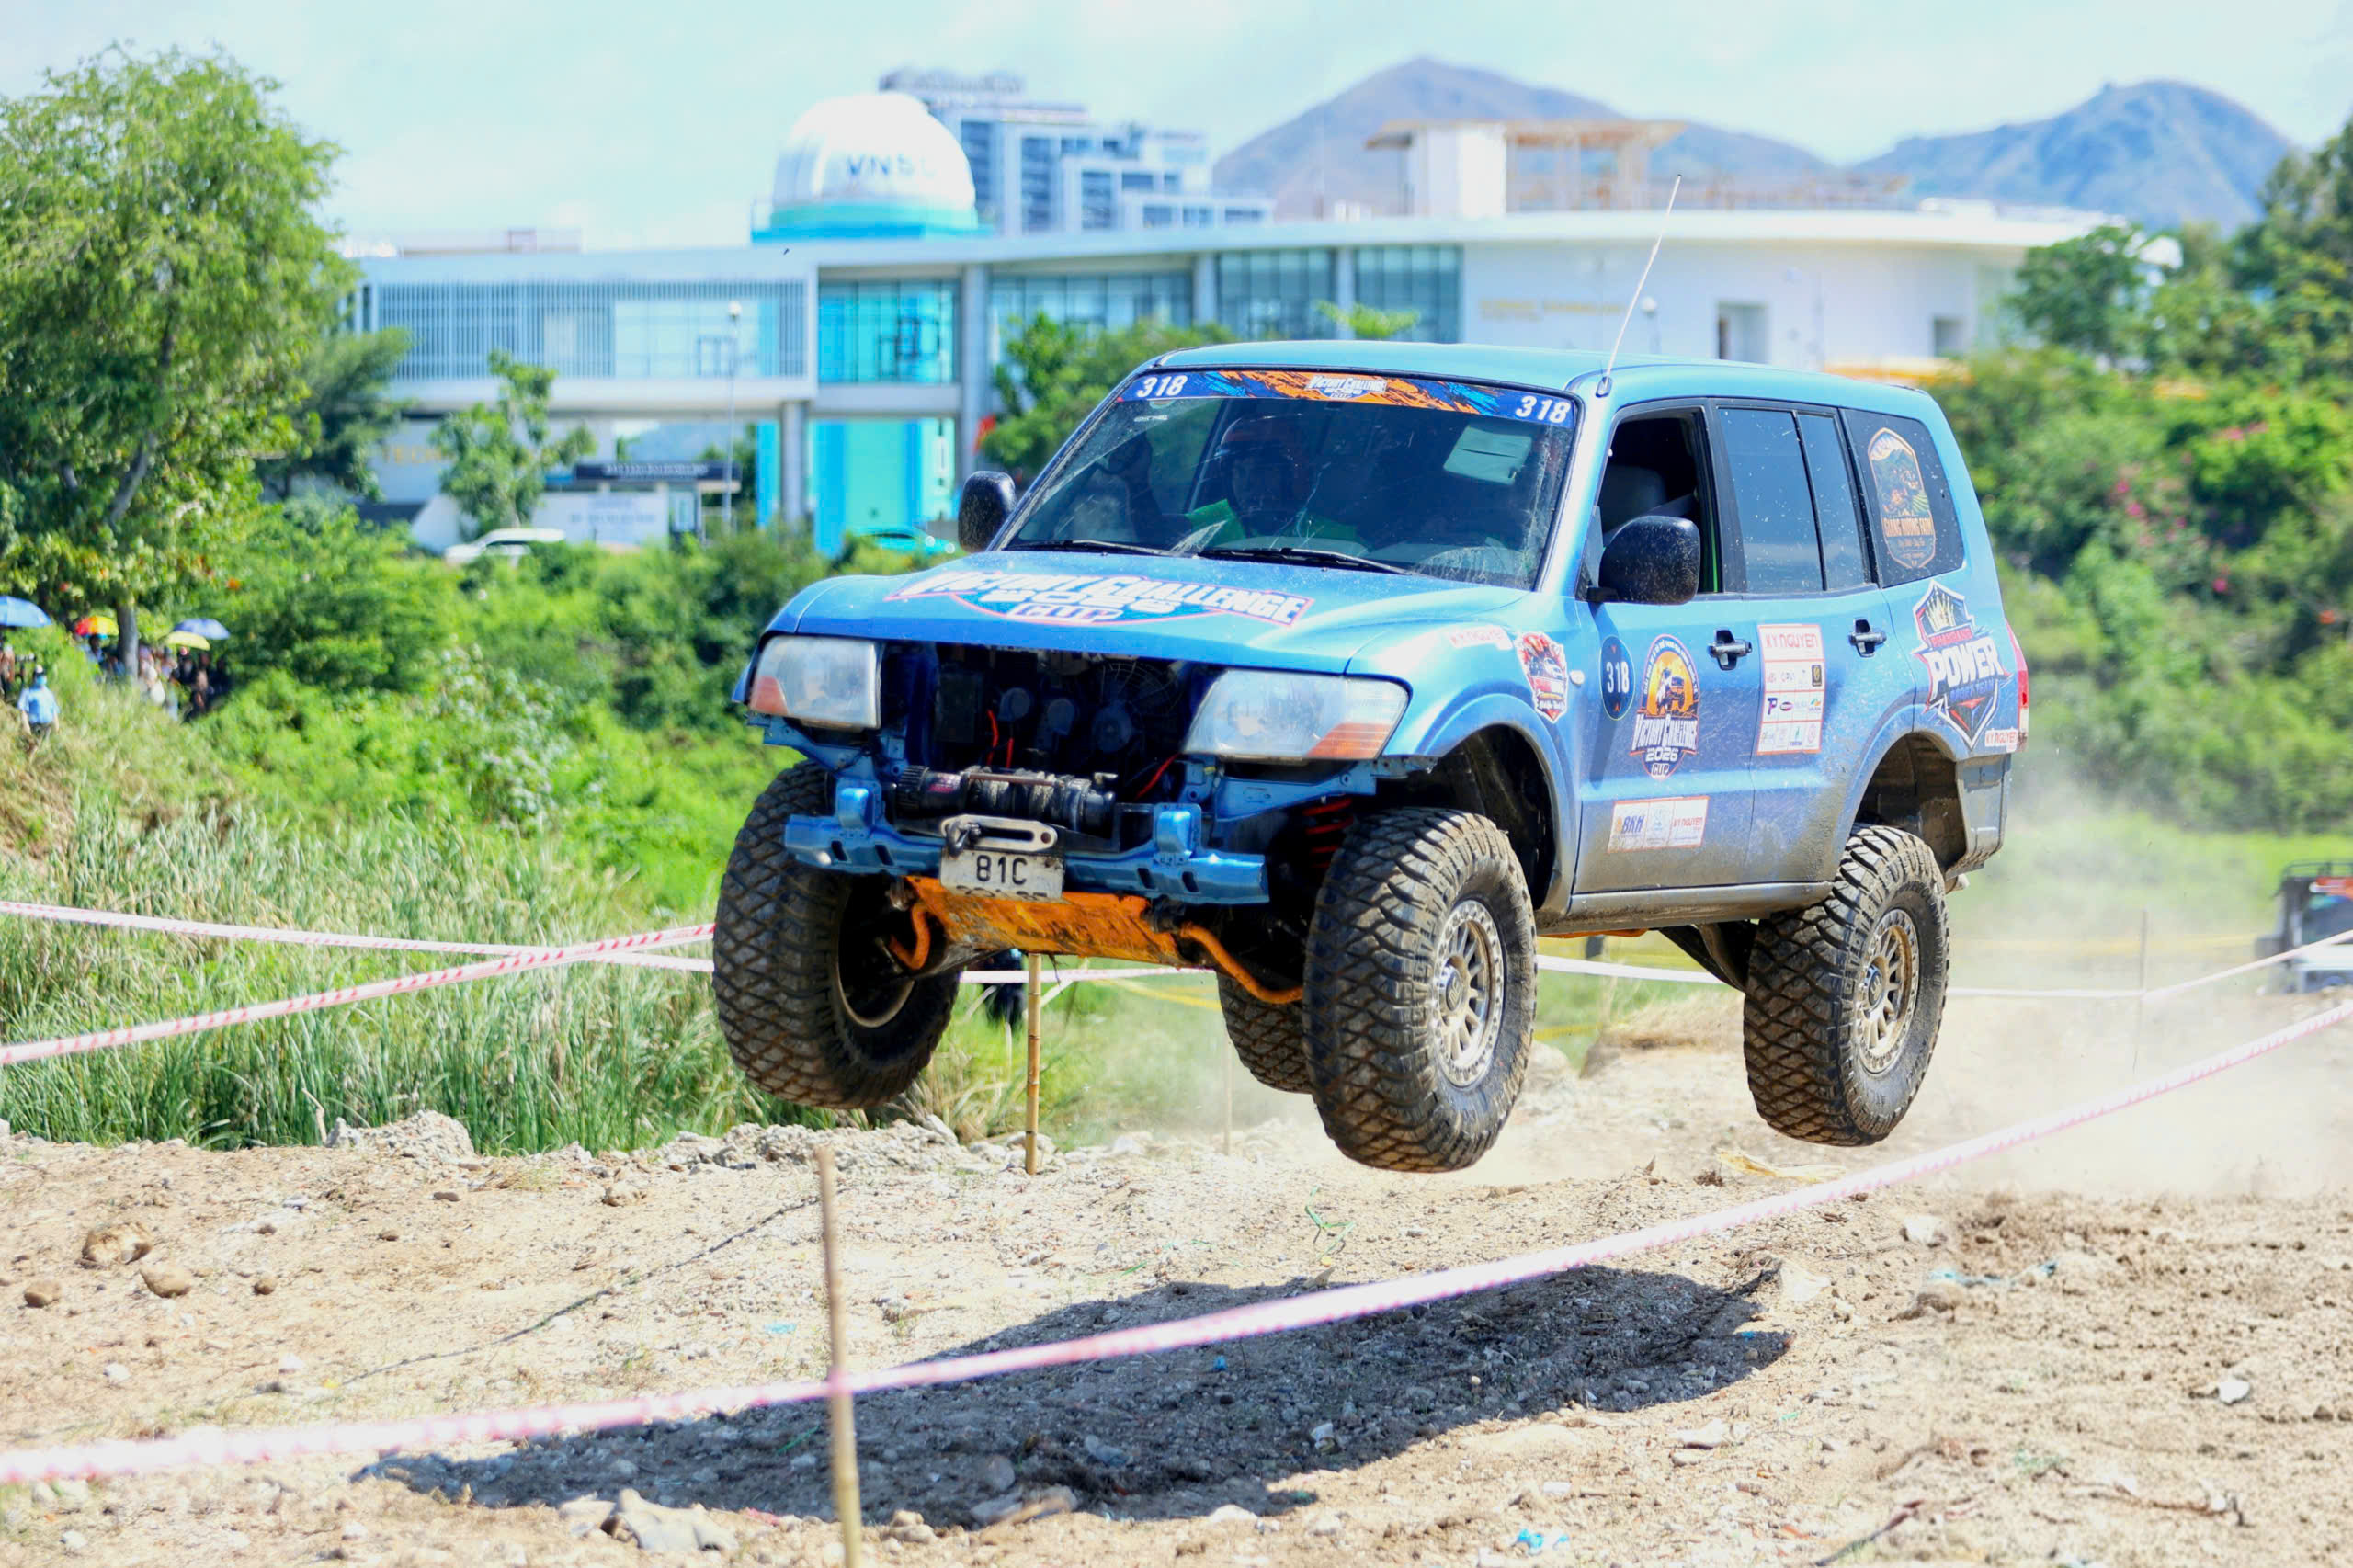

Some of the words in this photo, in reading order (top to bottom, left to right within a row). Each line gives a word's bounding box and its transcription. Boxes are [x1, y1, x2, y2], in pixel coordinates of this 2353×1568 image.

[1137, 375, 1188, 398] 318
[1515, 395, 1572, 423] 318
[1007, 601, 1123, 625] CUP
[1078, 575, 1307, 623] CHALLENGE
[1606, 661, 1630, 693] 318
[1922, 637, 2005, 701] POWER
[1632, 713, 1666, 750] VICTORY
[1662, 713, 1698, 750] CHALLENGE
[1645, 747, 1679, 762] 2026
[1652, 763, 1669, 777] CUP
[976, 855, 1028, 885] 81C
